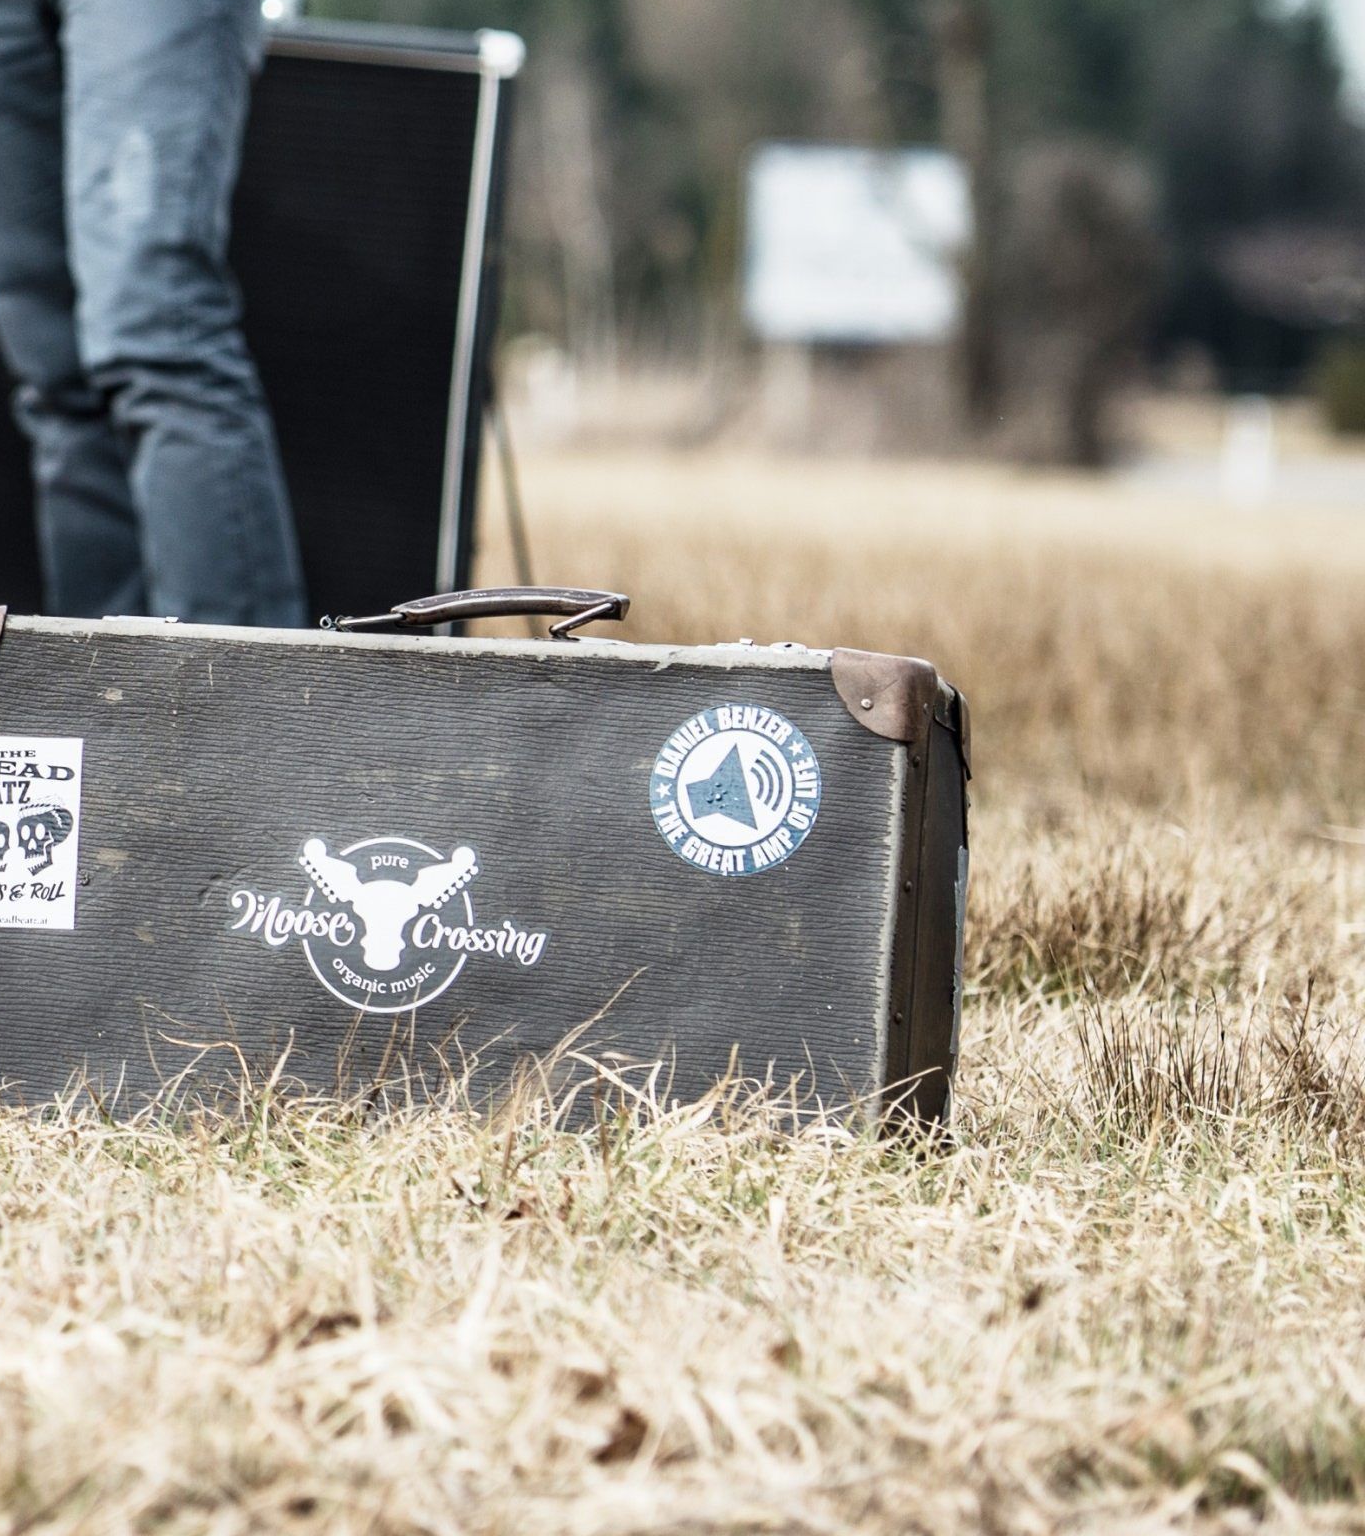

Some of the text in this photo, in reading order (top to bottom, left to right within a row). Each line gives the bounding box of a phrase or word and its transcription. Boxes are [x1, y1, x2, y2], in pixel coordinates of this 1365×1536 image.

[654, 705, 793, 780] DANIEL BENZER
[654, 756, 818, 873] THE GREAT AMP OF LIFE
[370, 853, 409, 870] pure
[8, 882, 26, 902] &
[31, 881, 66, 901] ROLL
[231, 889, 547, 966] Moose Crossing
[332, 957, 437, 995] organic music
